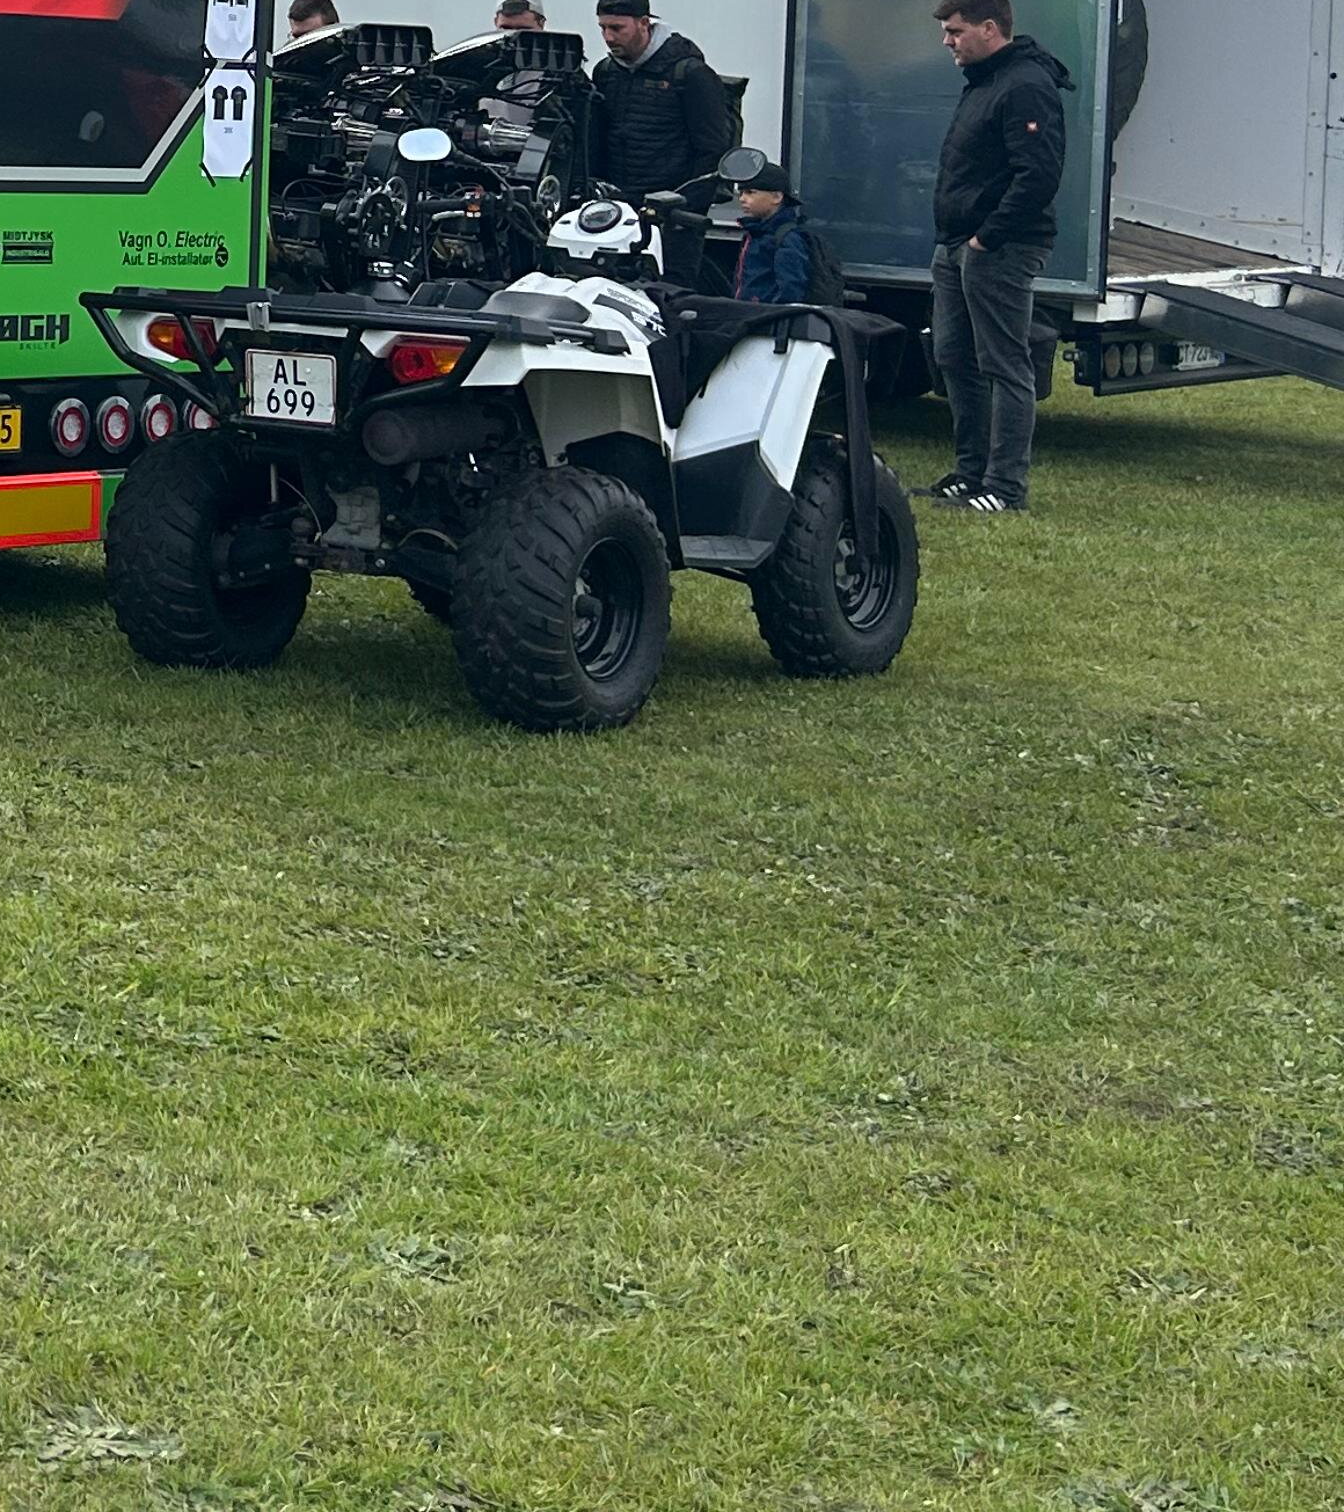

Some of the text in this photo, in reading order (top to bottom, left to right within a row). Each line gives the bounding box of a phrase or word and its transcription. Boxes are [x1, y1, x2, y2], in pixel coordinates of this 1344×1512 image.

[118, 230, 153, 251] Vagn
[175, 230, 225, 248] Electric
[273, 359, 306, 386] AL
[267, 388, 315, 416] 699
